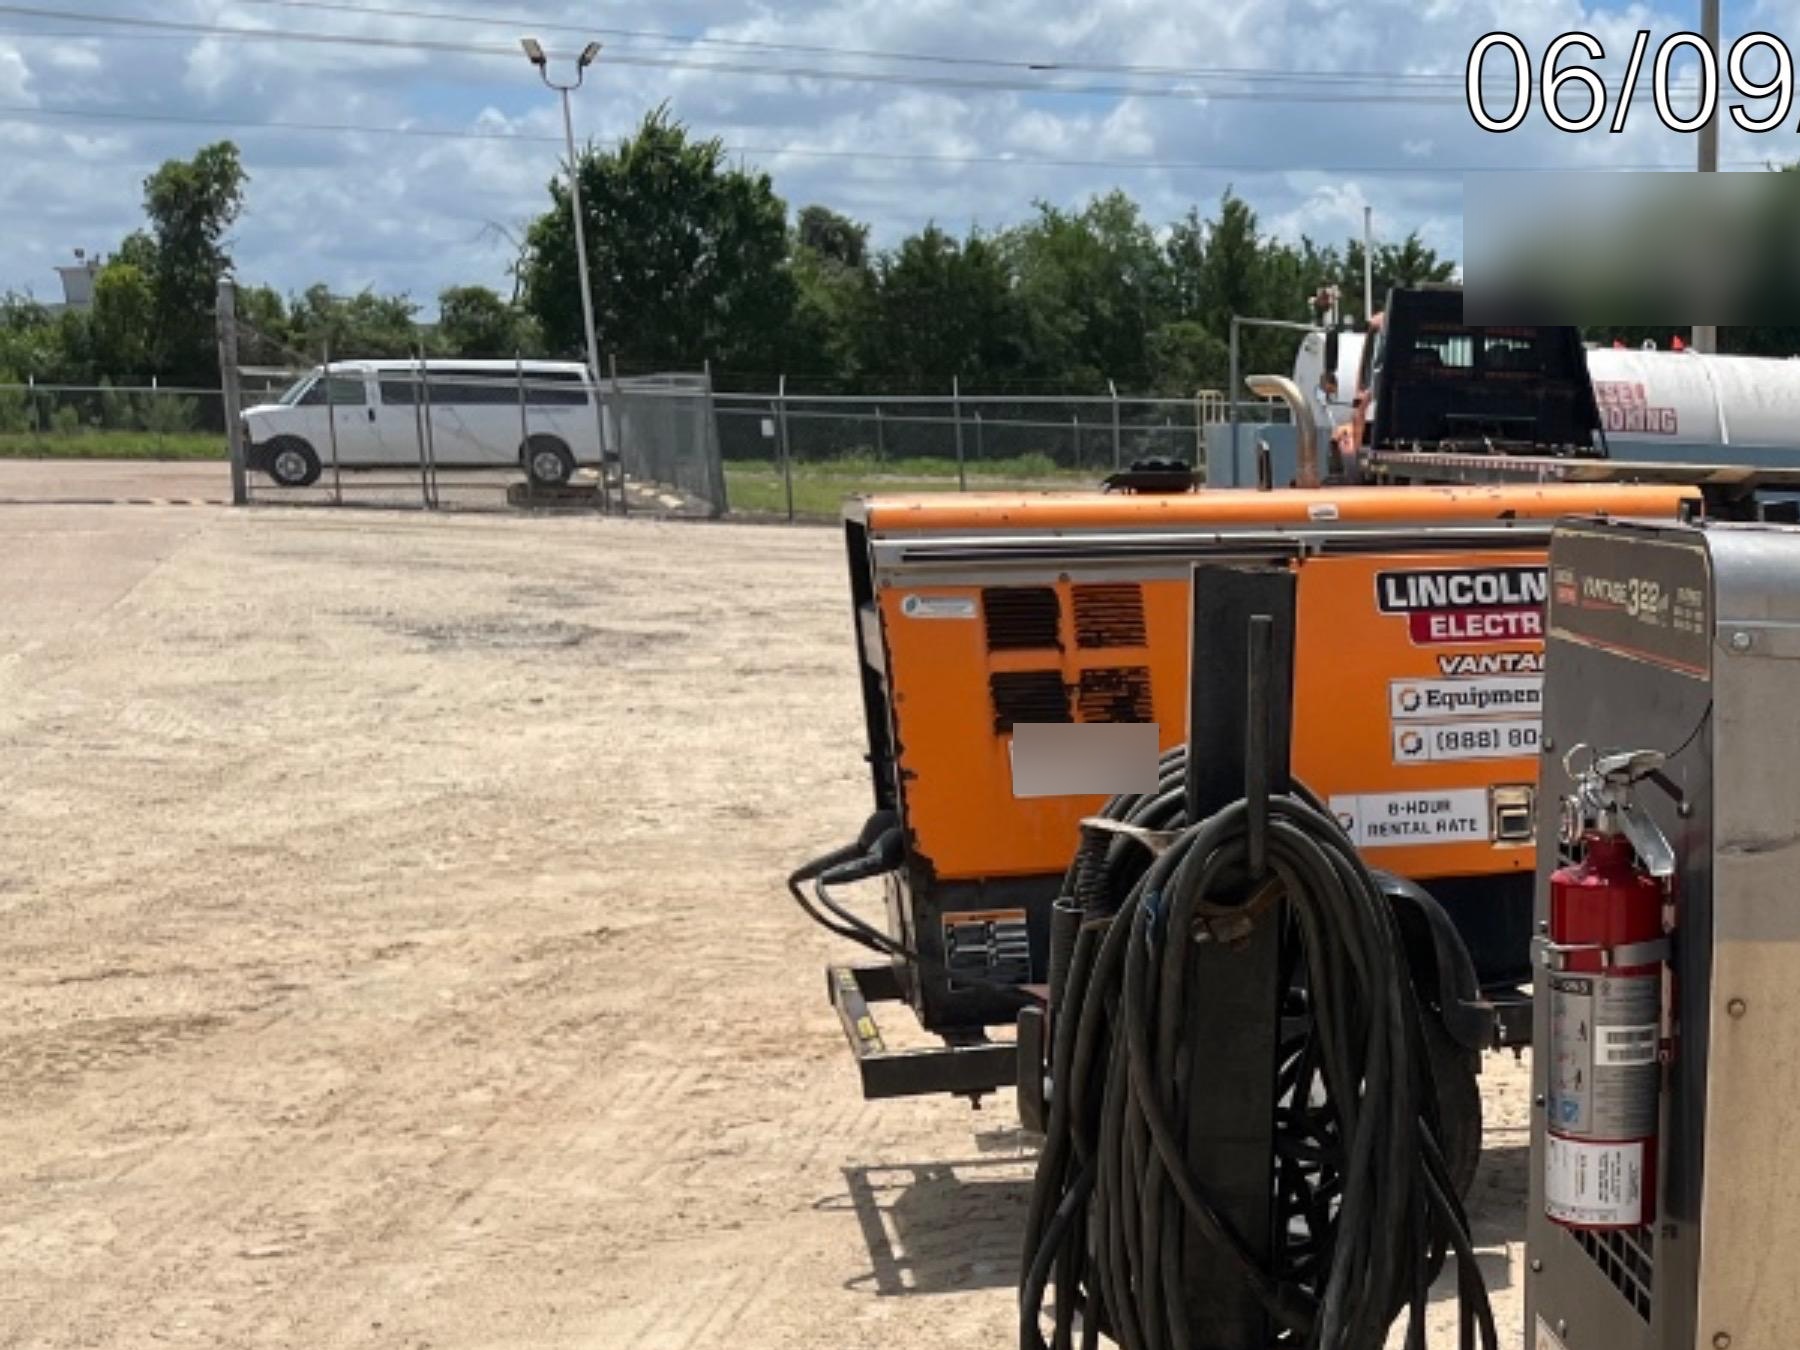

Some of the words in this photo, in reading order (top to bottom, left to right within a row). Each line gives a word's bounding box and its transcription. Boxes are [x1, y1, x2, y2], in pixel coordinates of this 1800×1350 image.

[1386, 571, 1547, 608] LINCOLN
[1430, 611, 1542, 639] ELECTR
[1438, 652, 1546, 676] VANTA
[1425, 686, 1541, 711] Equipmen
[1436, 727, 1499, 751] (888)
[1508, 727, 1541, 747] 80
